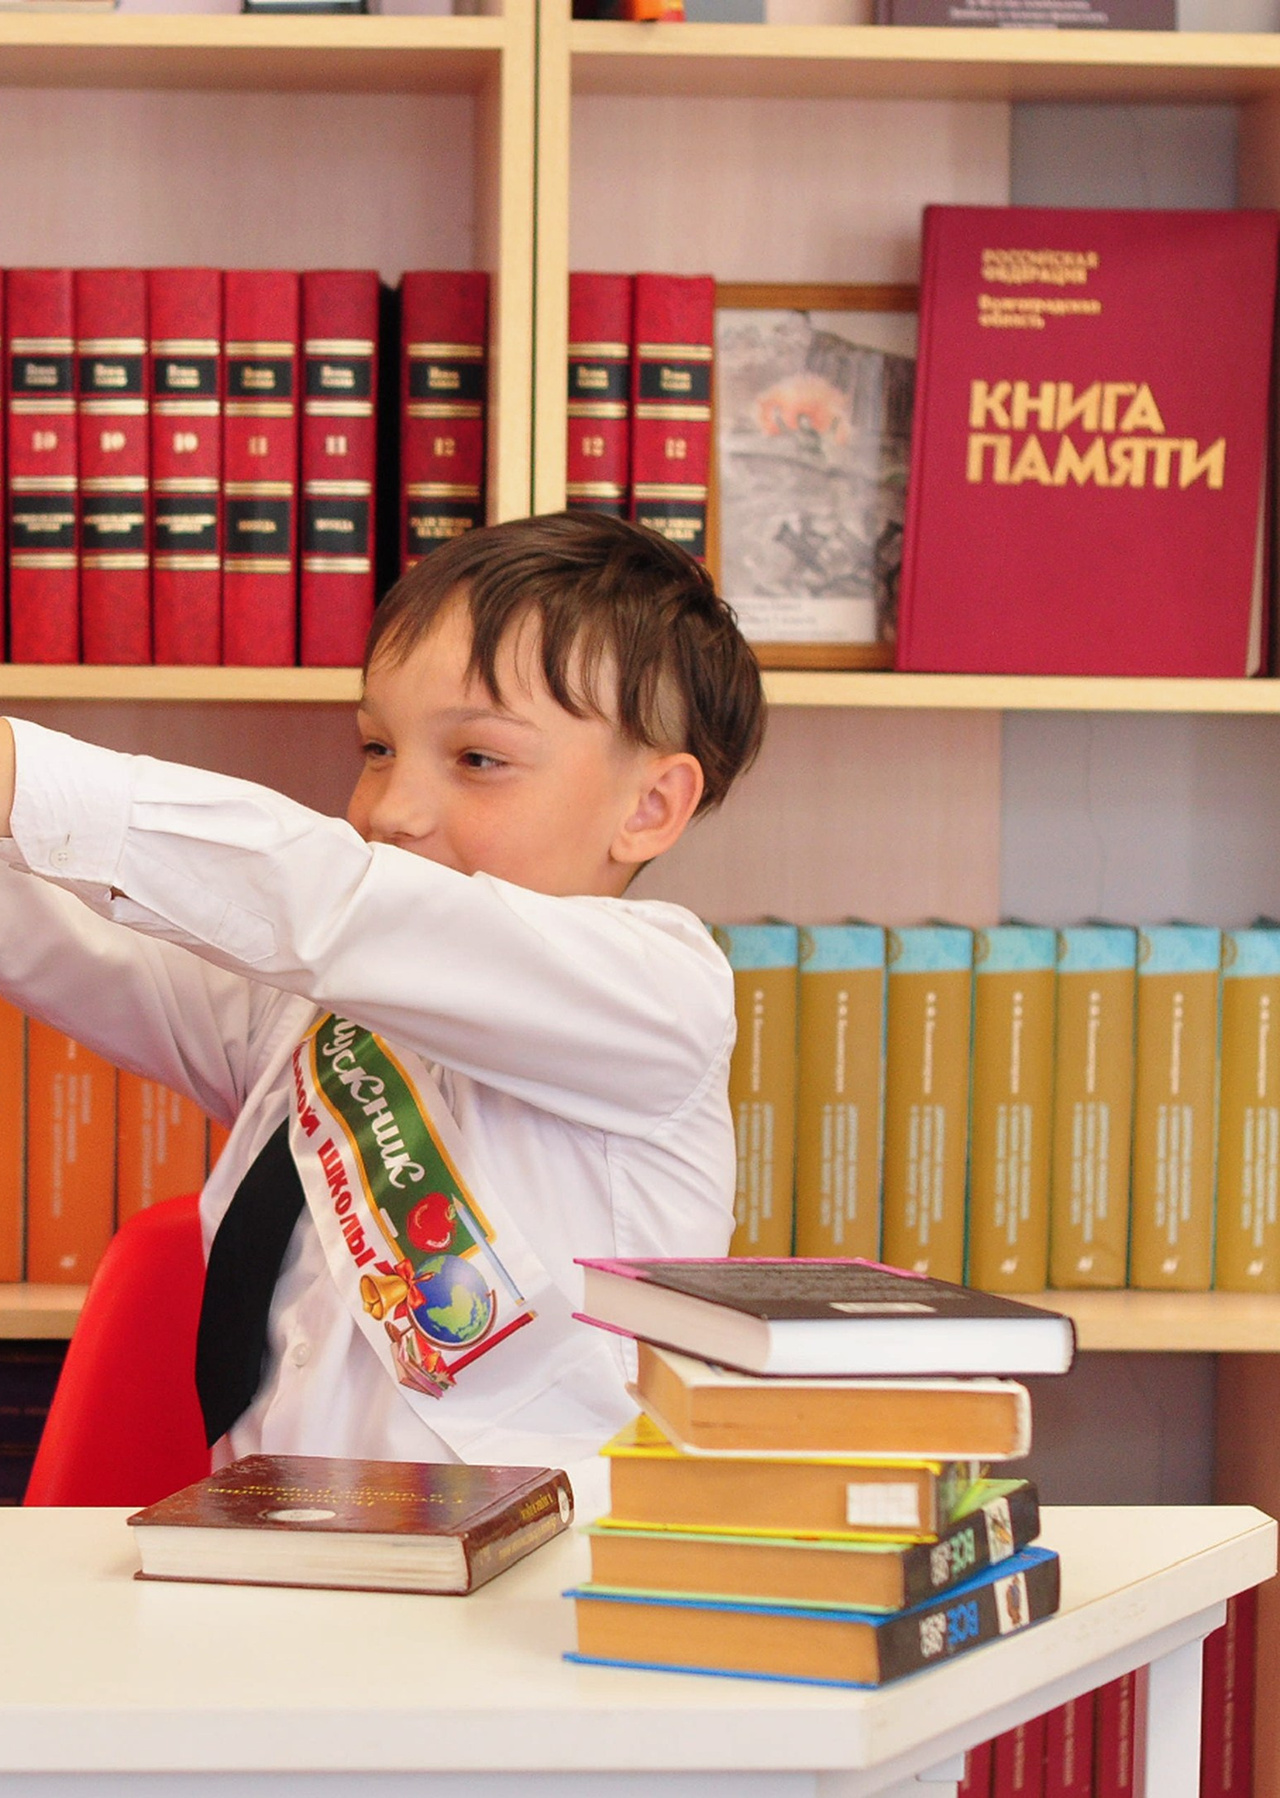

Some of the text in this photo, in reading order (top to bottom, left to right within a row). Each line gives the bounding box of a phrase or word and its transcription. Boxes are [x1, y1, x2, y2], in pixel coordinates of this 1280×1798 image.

[969, 380, 1166, 435] КНИГА
[966, 432, 1227, 490] ПАМЯТИ
[316, 1136, 377, 1269] ШКОЛЫ
